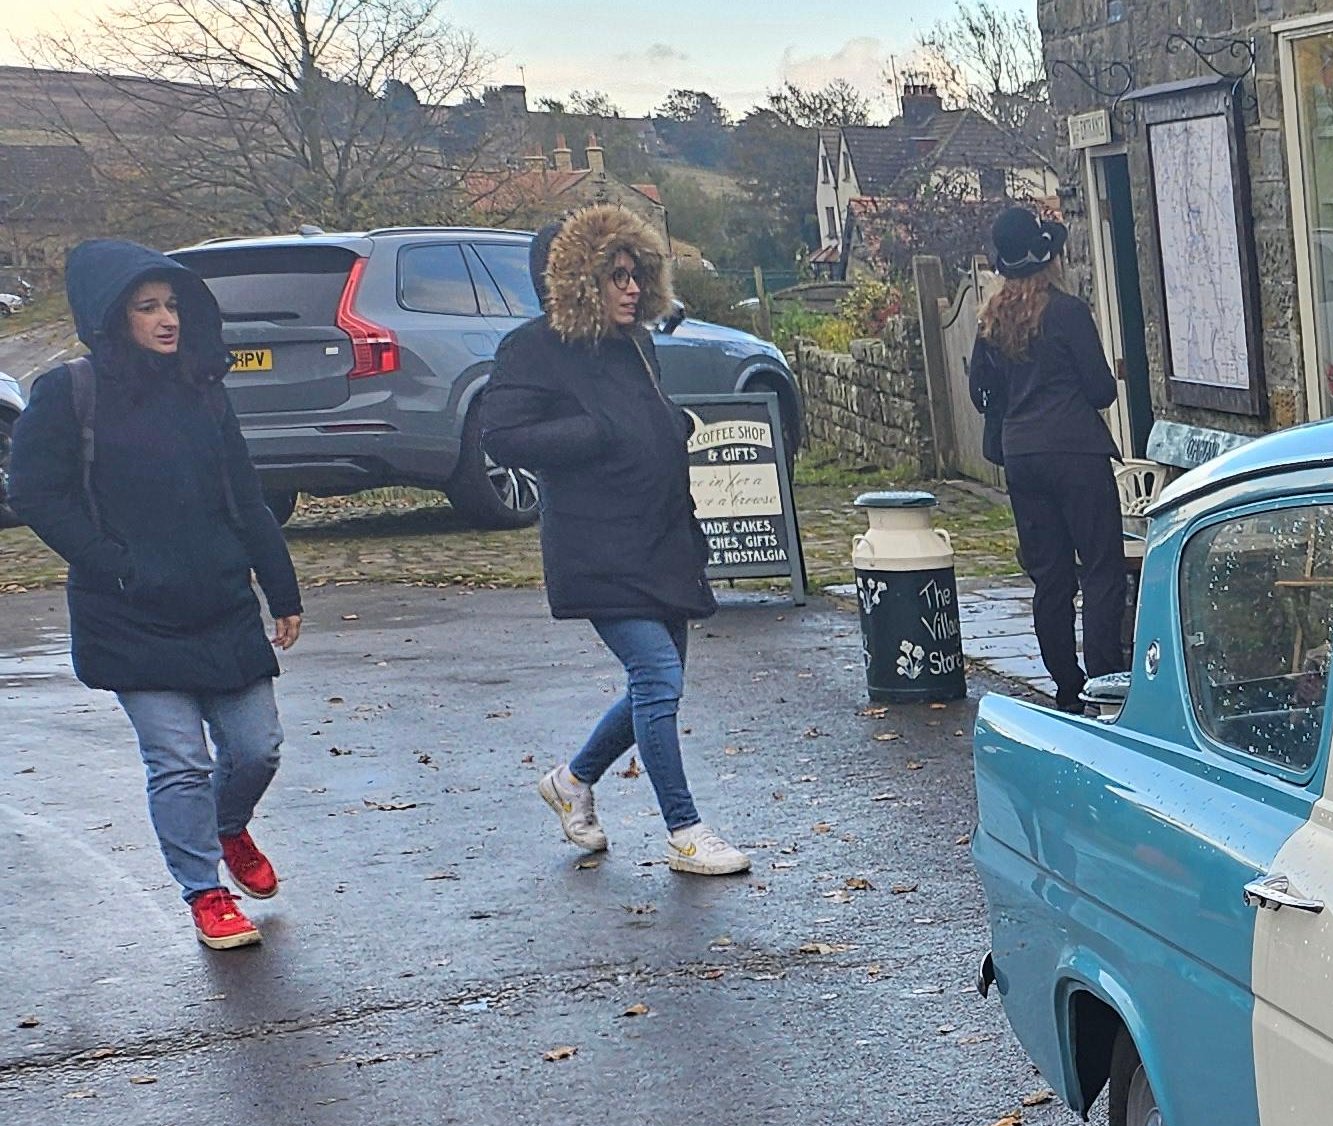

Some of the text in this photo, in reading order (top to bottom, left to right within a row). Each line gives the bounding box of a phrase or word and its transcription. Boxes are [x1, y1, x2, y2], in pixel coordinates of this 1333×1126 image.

[696, 423, 766, 445] COFFEE SHOP
[722, 447, 758, 461] GIFTS
[733, 519, 775, 534] CAKES,
[745, 534, 778, 547] GIFTS
[724, 549, 787, 564] NOSTALGIA
[919, 579, 951, 608] The
